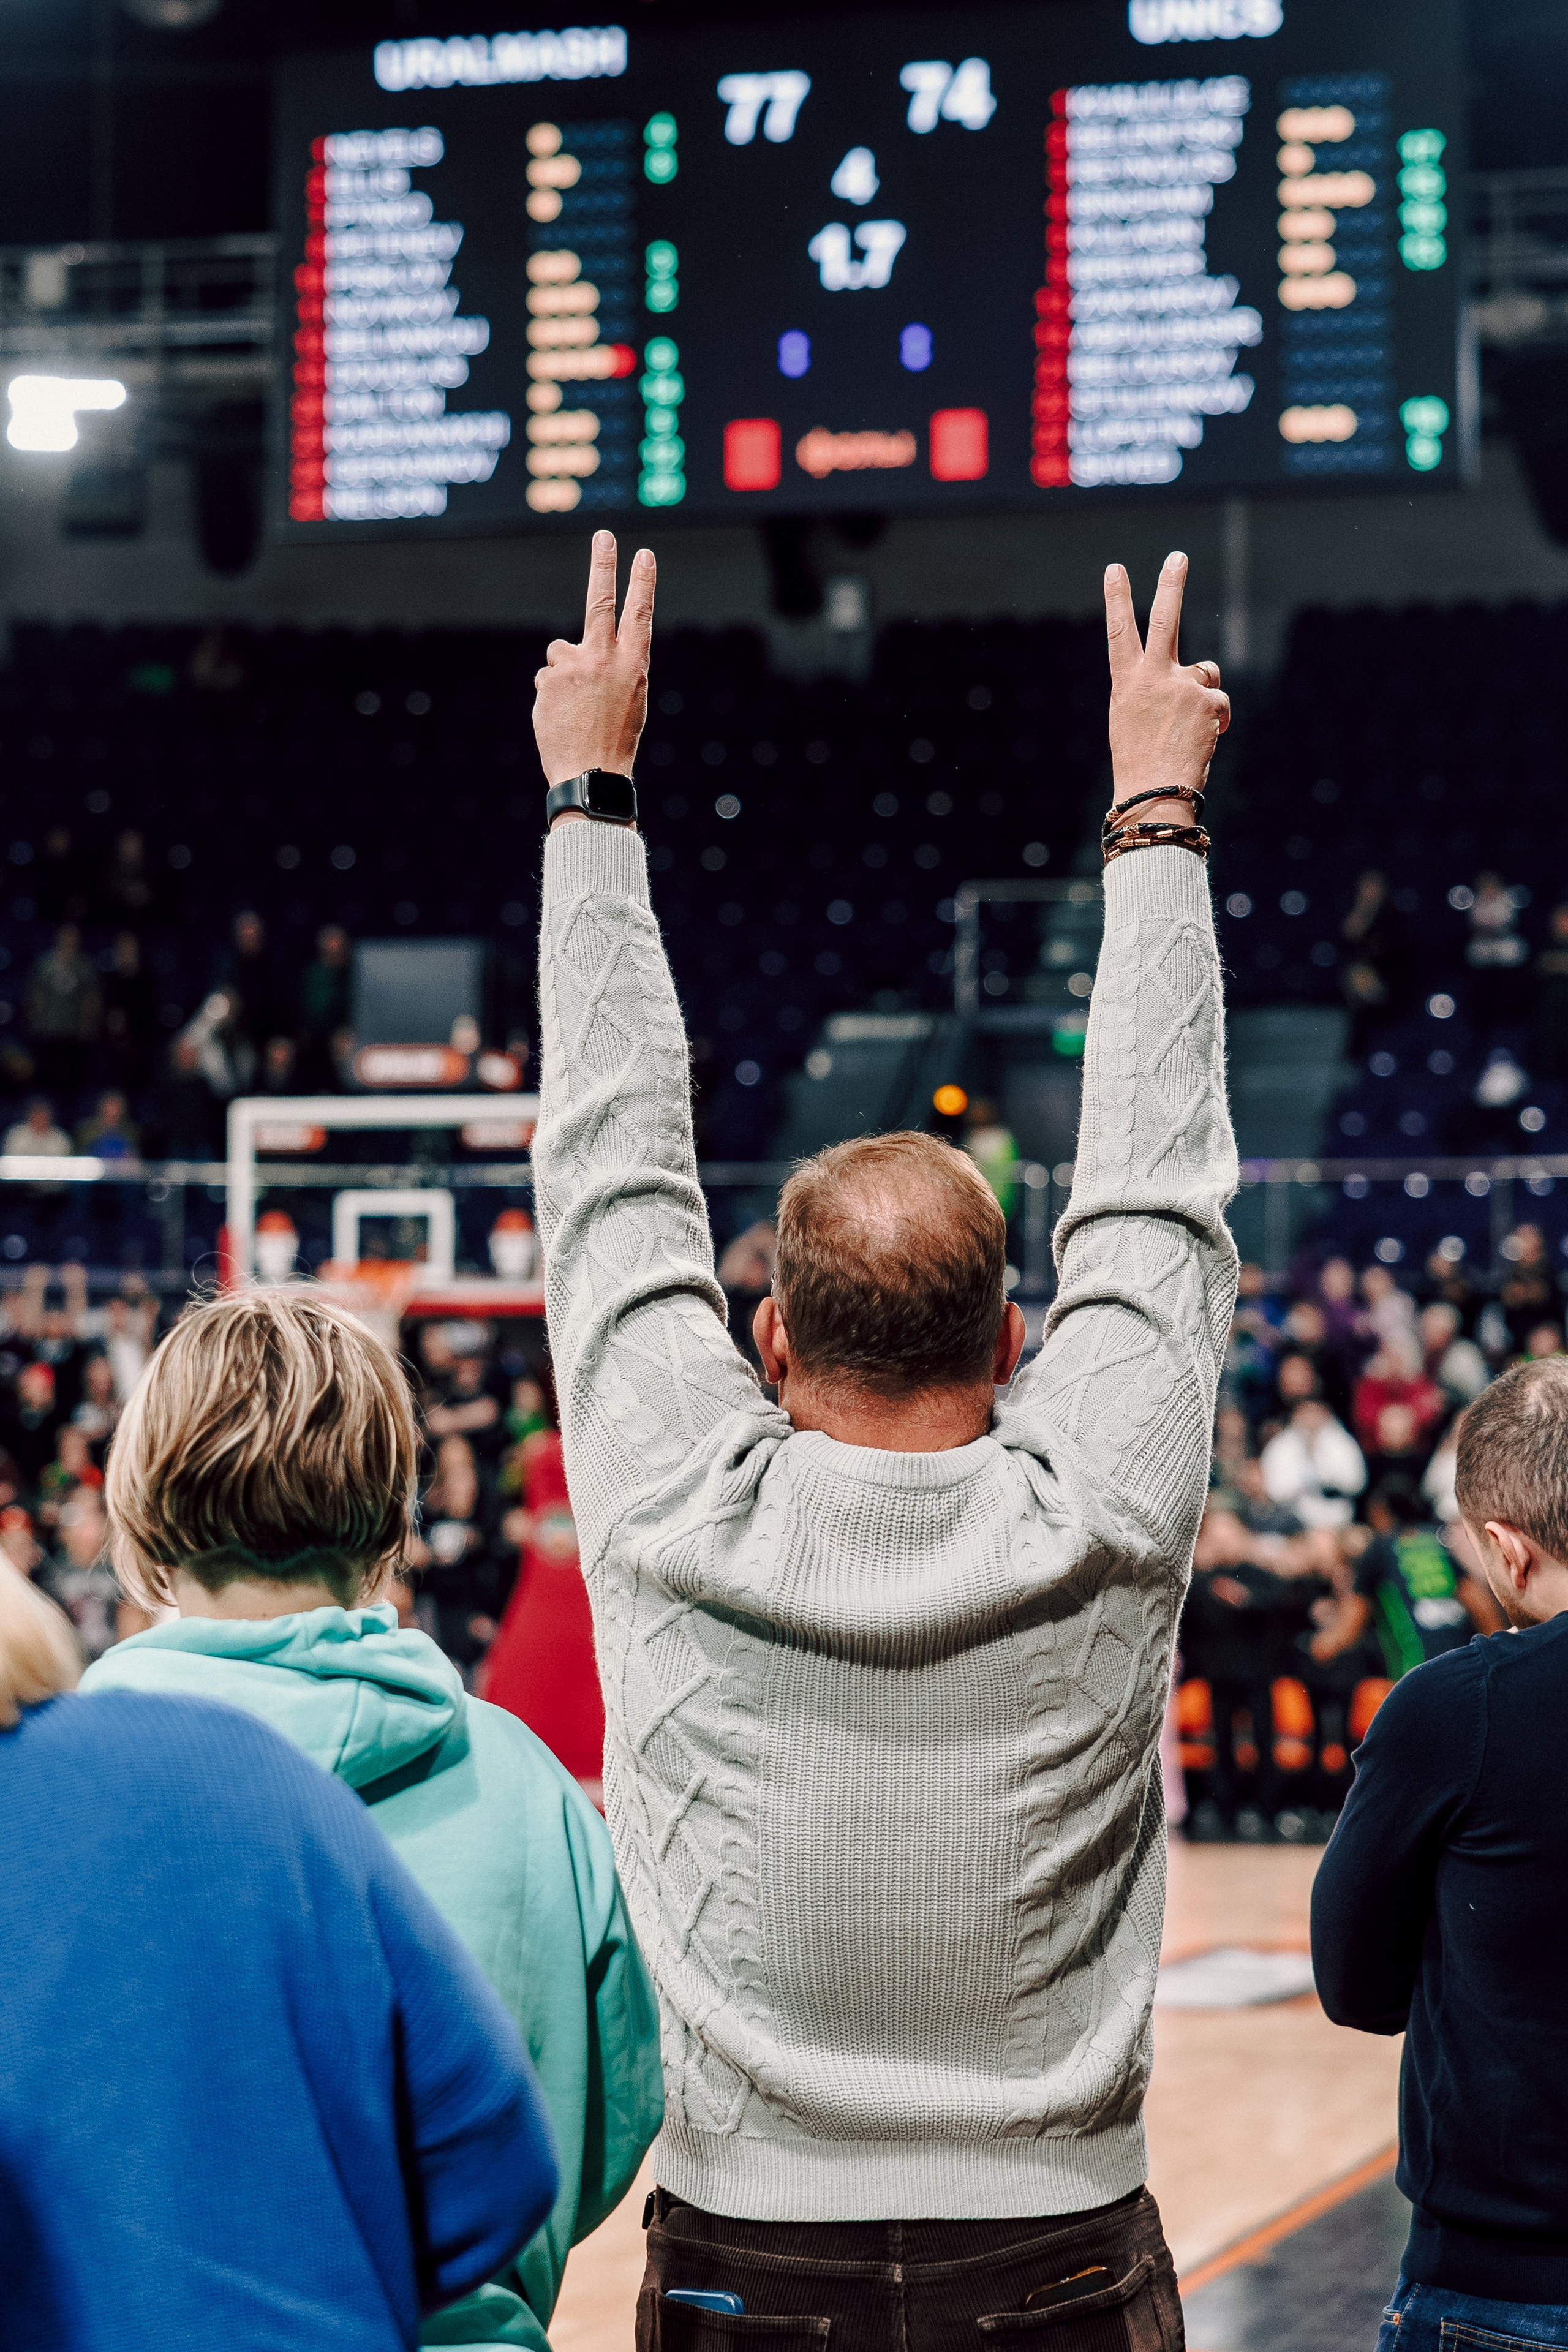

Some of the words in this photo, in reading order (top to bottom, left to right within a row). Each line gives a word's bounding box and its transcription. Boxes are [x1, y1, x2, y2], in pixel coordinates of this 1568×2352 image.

[717, 70, 811, 145] 77
[900, 57, 997, 134] 74
[831, 146, 879, 205] 4
